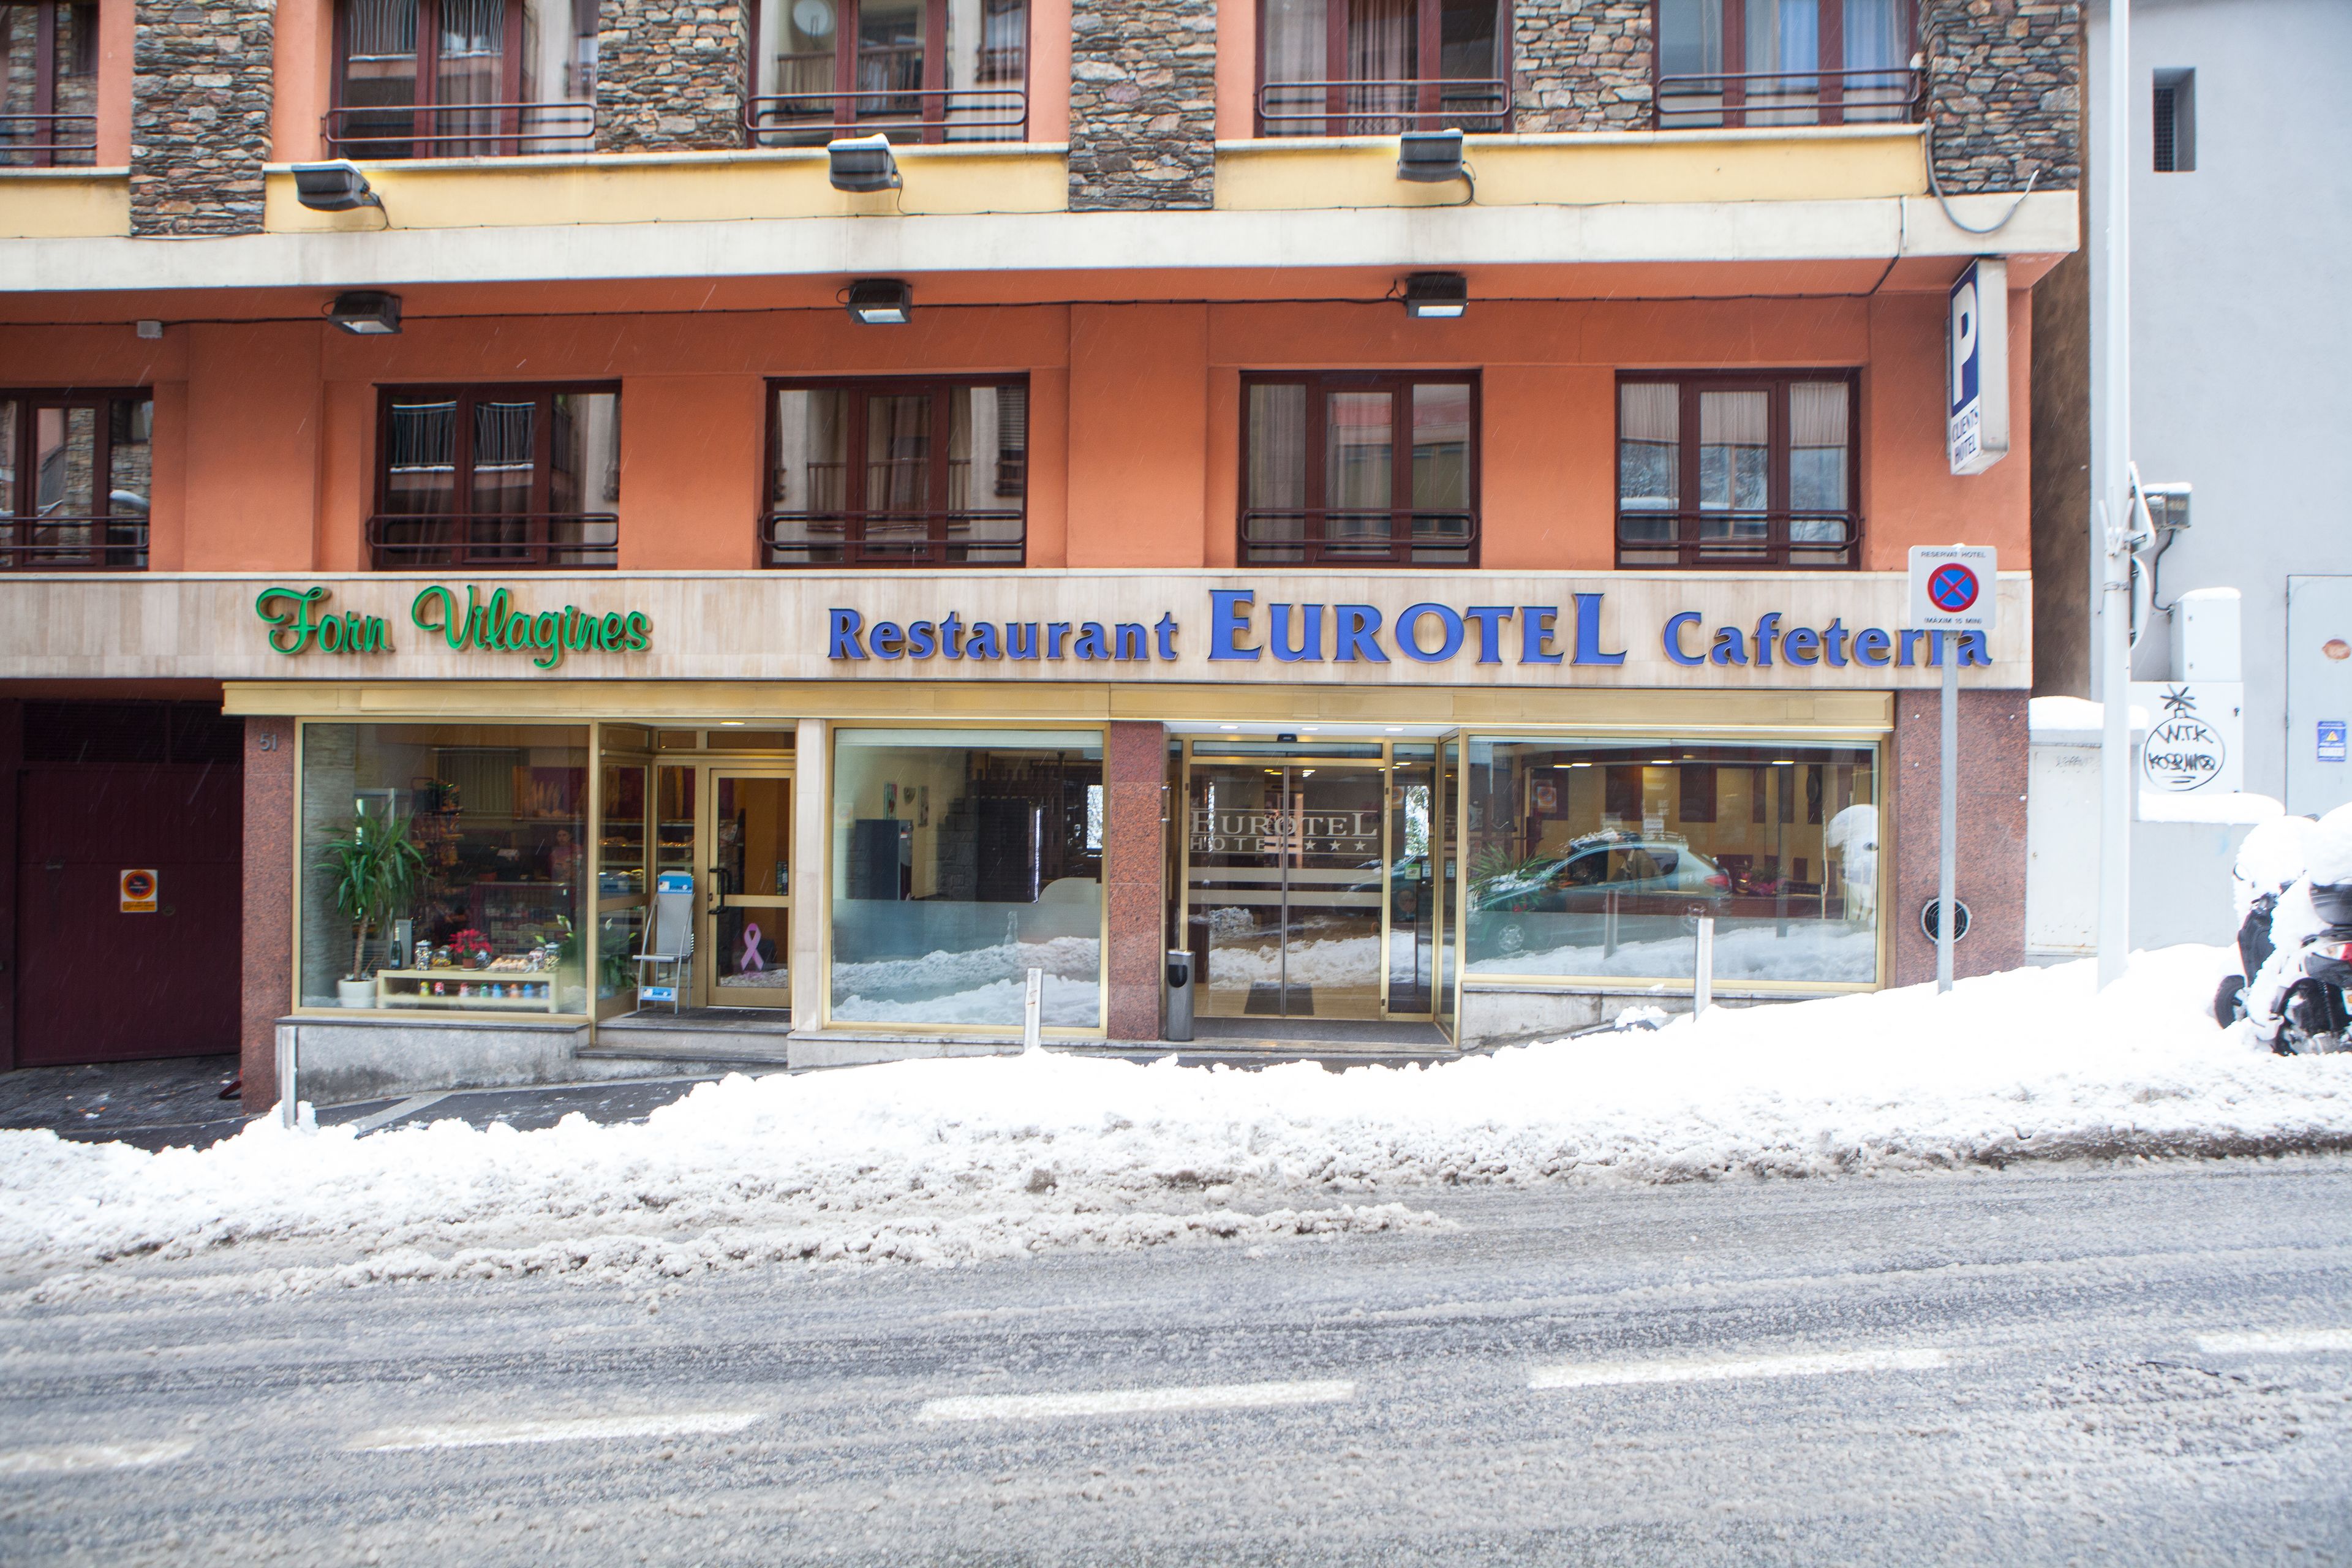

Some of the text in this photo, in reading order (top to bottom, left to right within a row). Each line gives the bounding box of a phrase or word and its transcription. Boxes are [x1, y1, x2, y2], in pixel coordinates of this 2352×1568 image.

[1951, 281, 1978, 407] P
[1953, 405, 1979, 442] CLIENTS
[1954, 432, 1977, 466] HOTEL
[255, 584, 653, 669] Forn Vilagines
[827, 608, 1180, 660] Restaurant
[1207, 589, 1628, 666] EUROTEL
[260, 733, 278, 752] 51
[1190, 810, 1378, 837] EUROTEL
